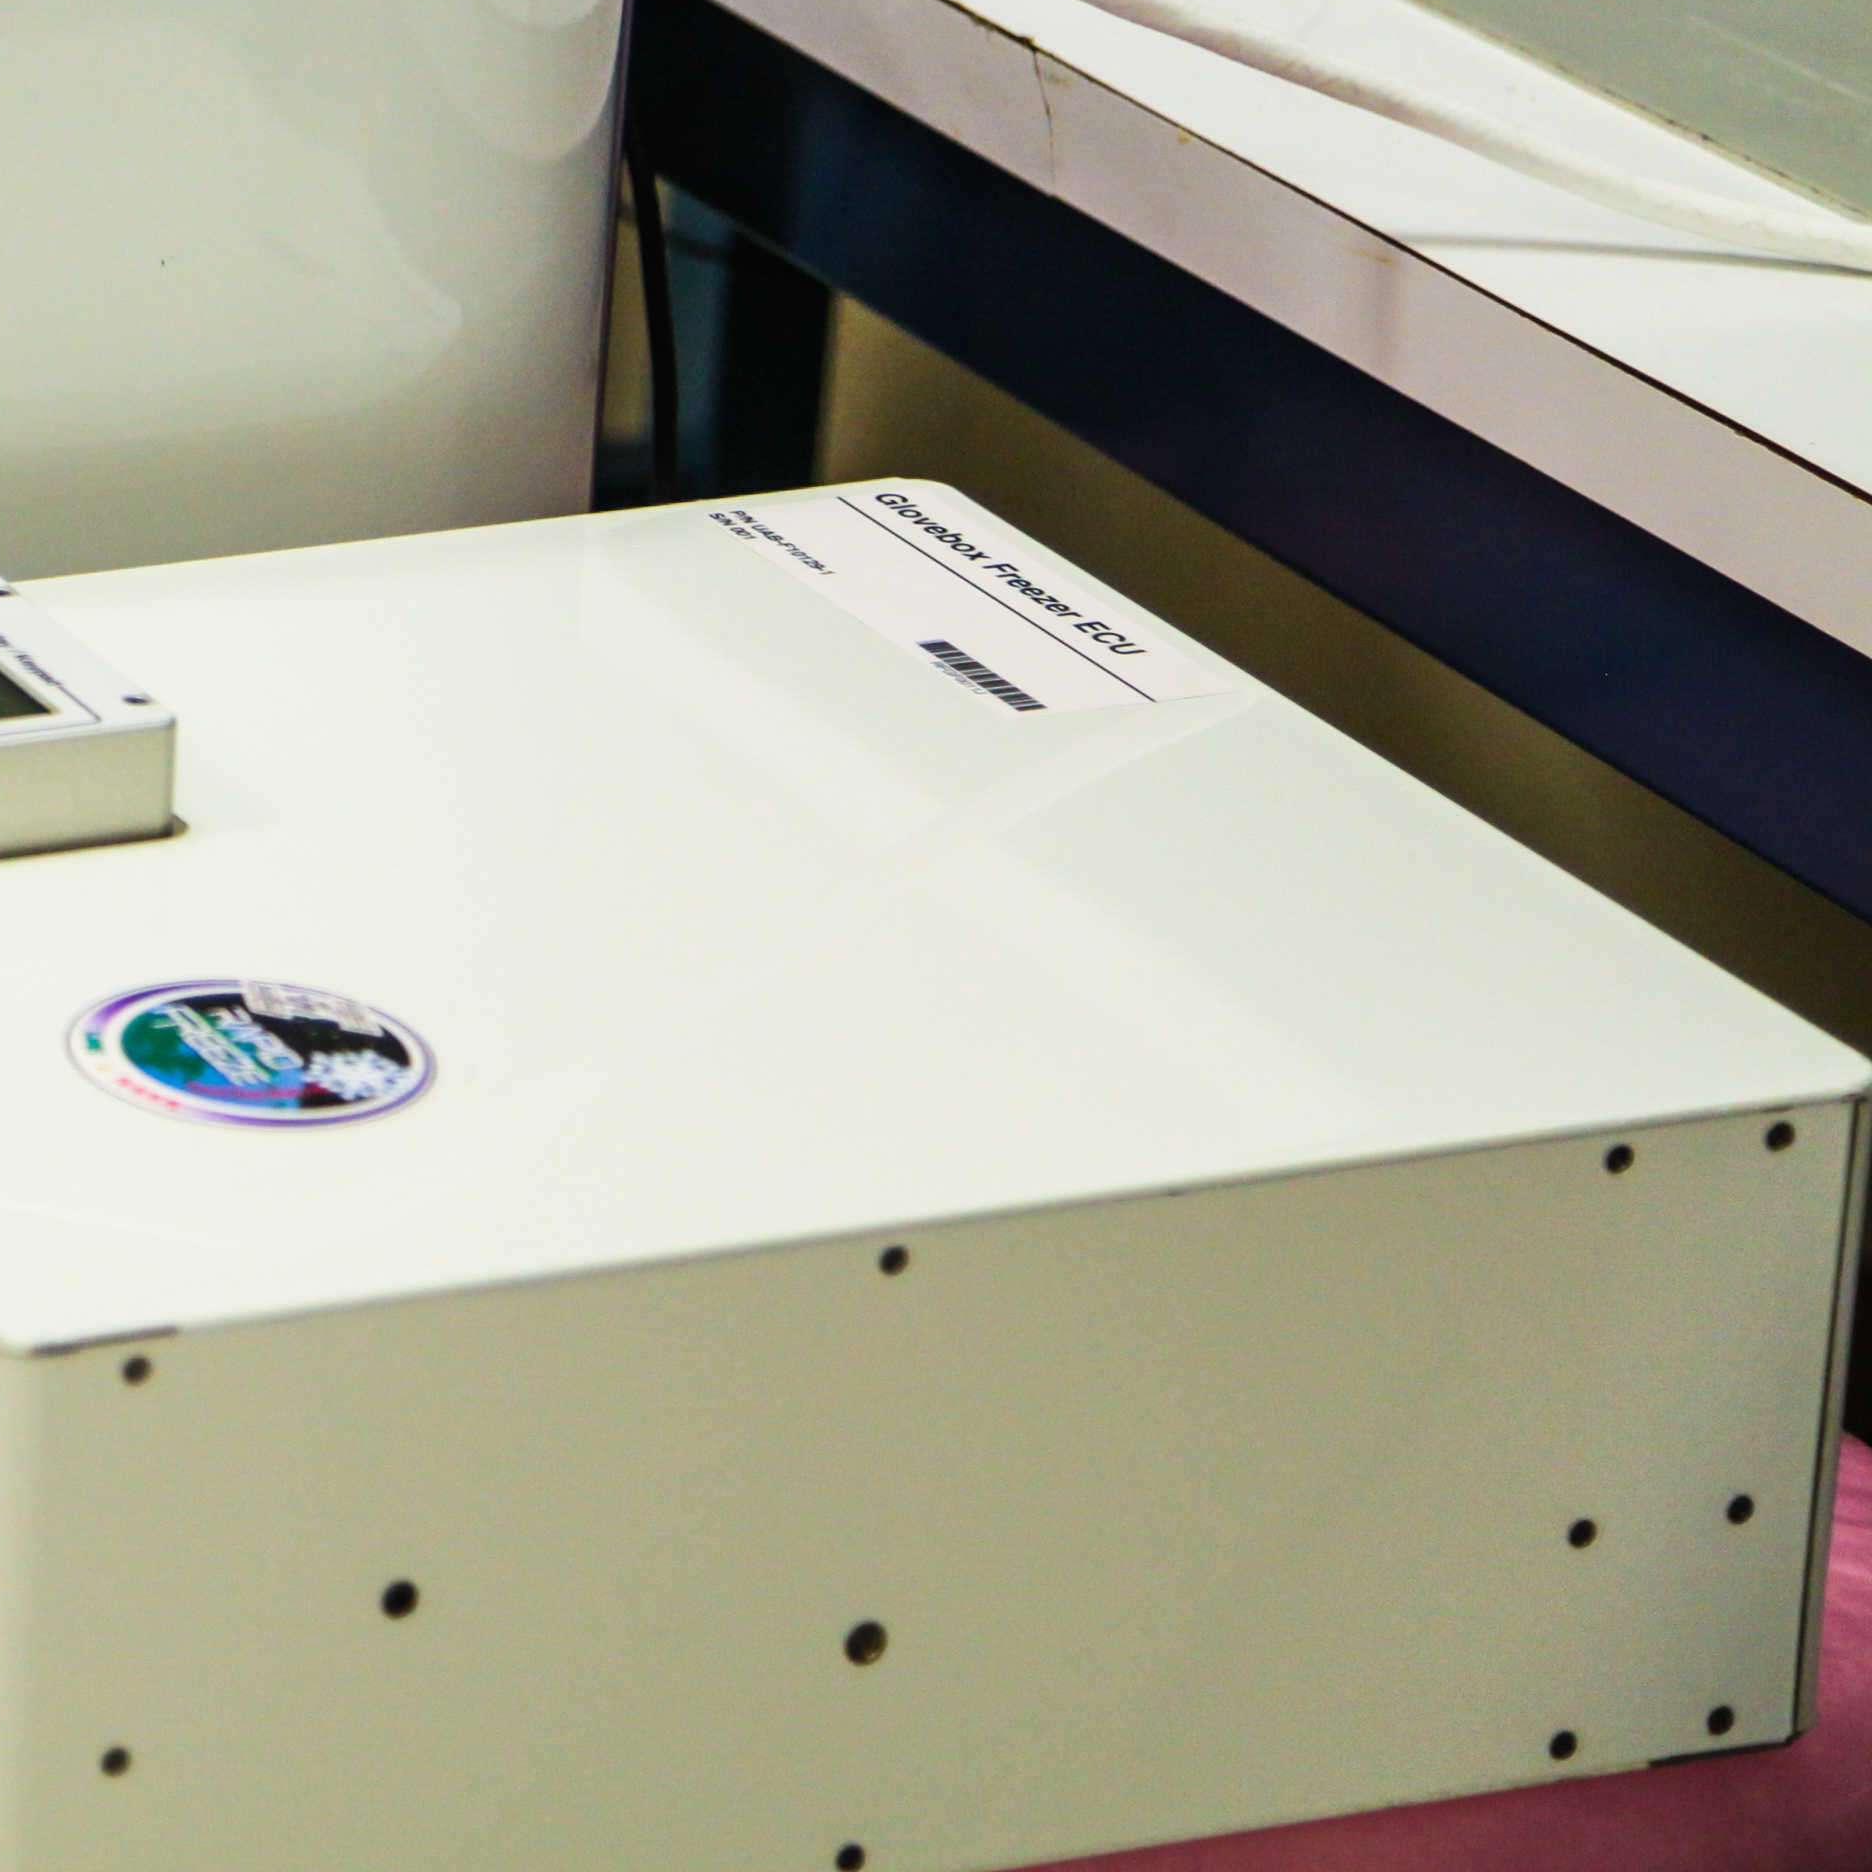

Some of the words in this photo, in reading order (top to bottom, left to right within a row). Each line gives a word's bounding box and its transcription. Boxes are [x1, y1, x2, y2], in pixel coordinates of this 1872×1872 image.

[874, 491, 992, 562] Glovebox
[983, 562, 1084, 619] Freezer
[1072, 619, 1147, 657] ECU
